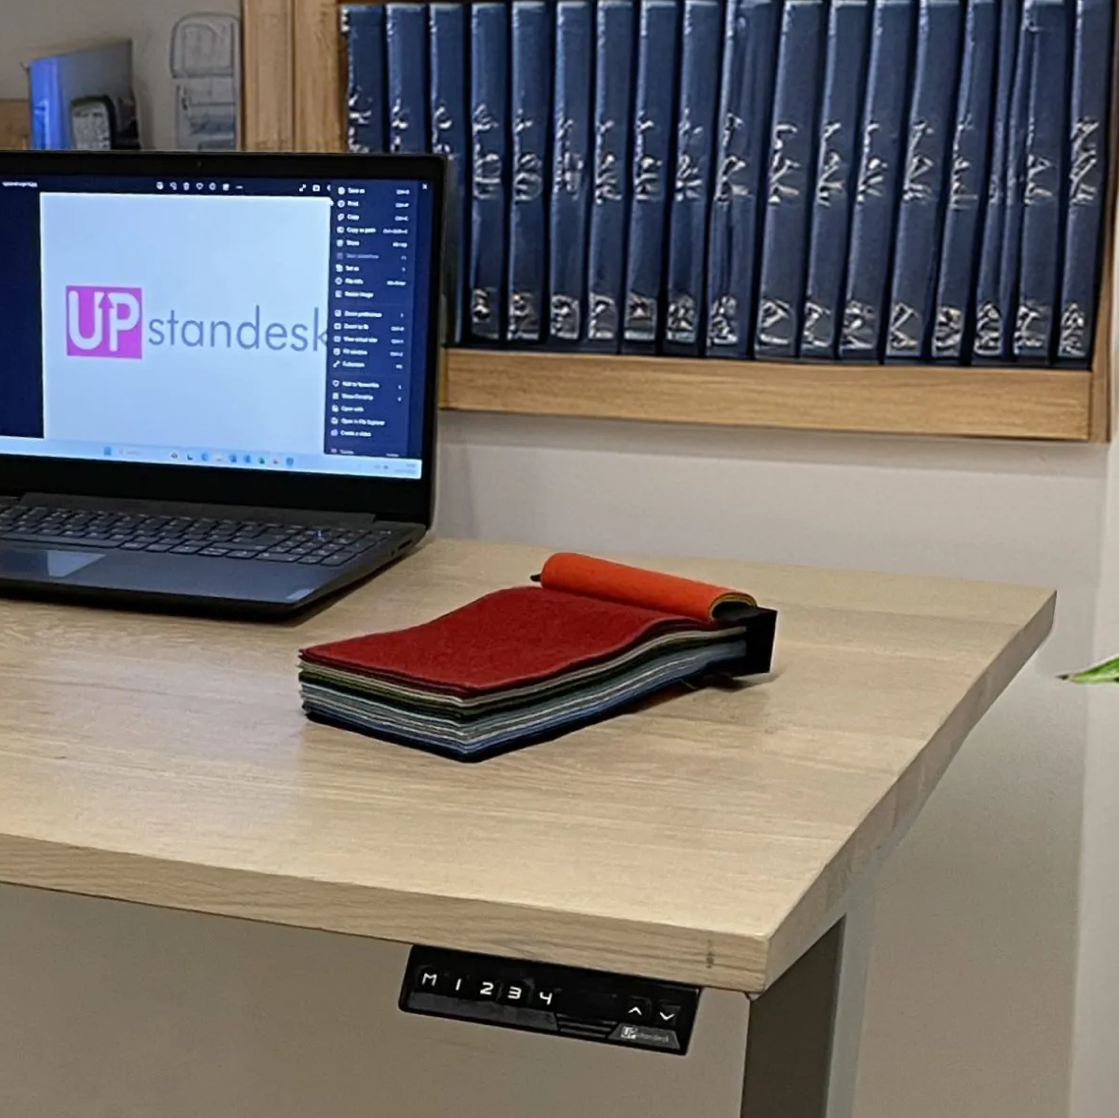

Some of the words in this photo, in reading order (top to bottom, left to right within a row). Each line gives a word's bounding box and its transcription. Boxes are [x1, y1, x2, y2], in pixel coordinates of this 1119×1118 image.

[68, 290, 140, 352] UP
[148, 304, 328, 352] standesk
[422, 973, 437, 986] M
[480, 981, 494, 995] 2
[507, 986, 522, 1000] 3
[539, 991, 553, 1005] 4
